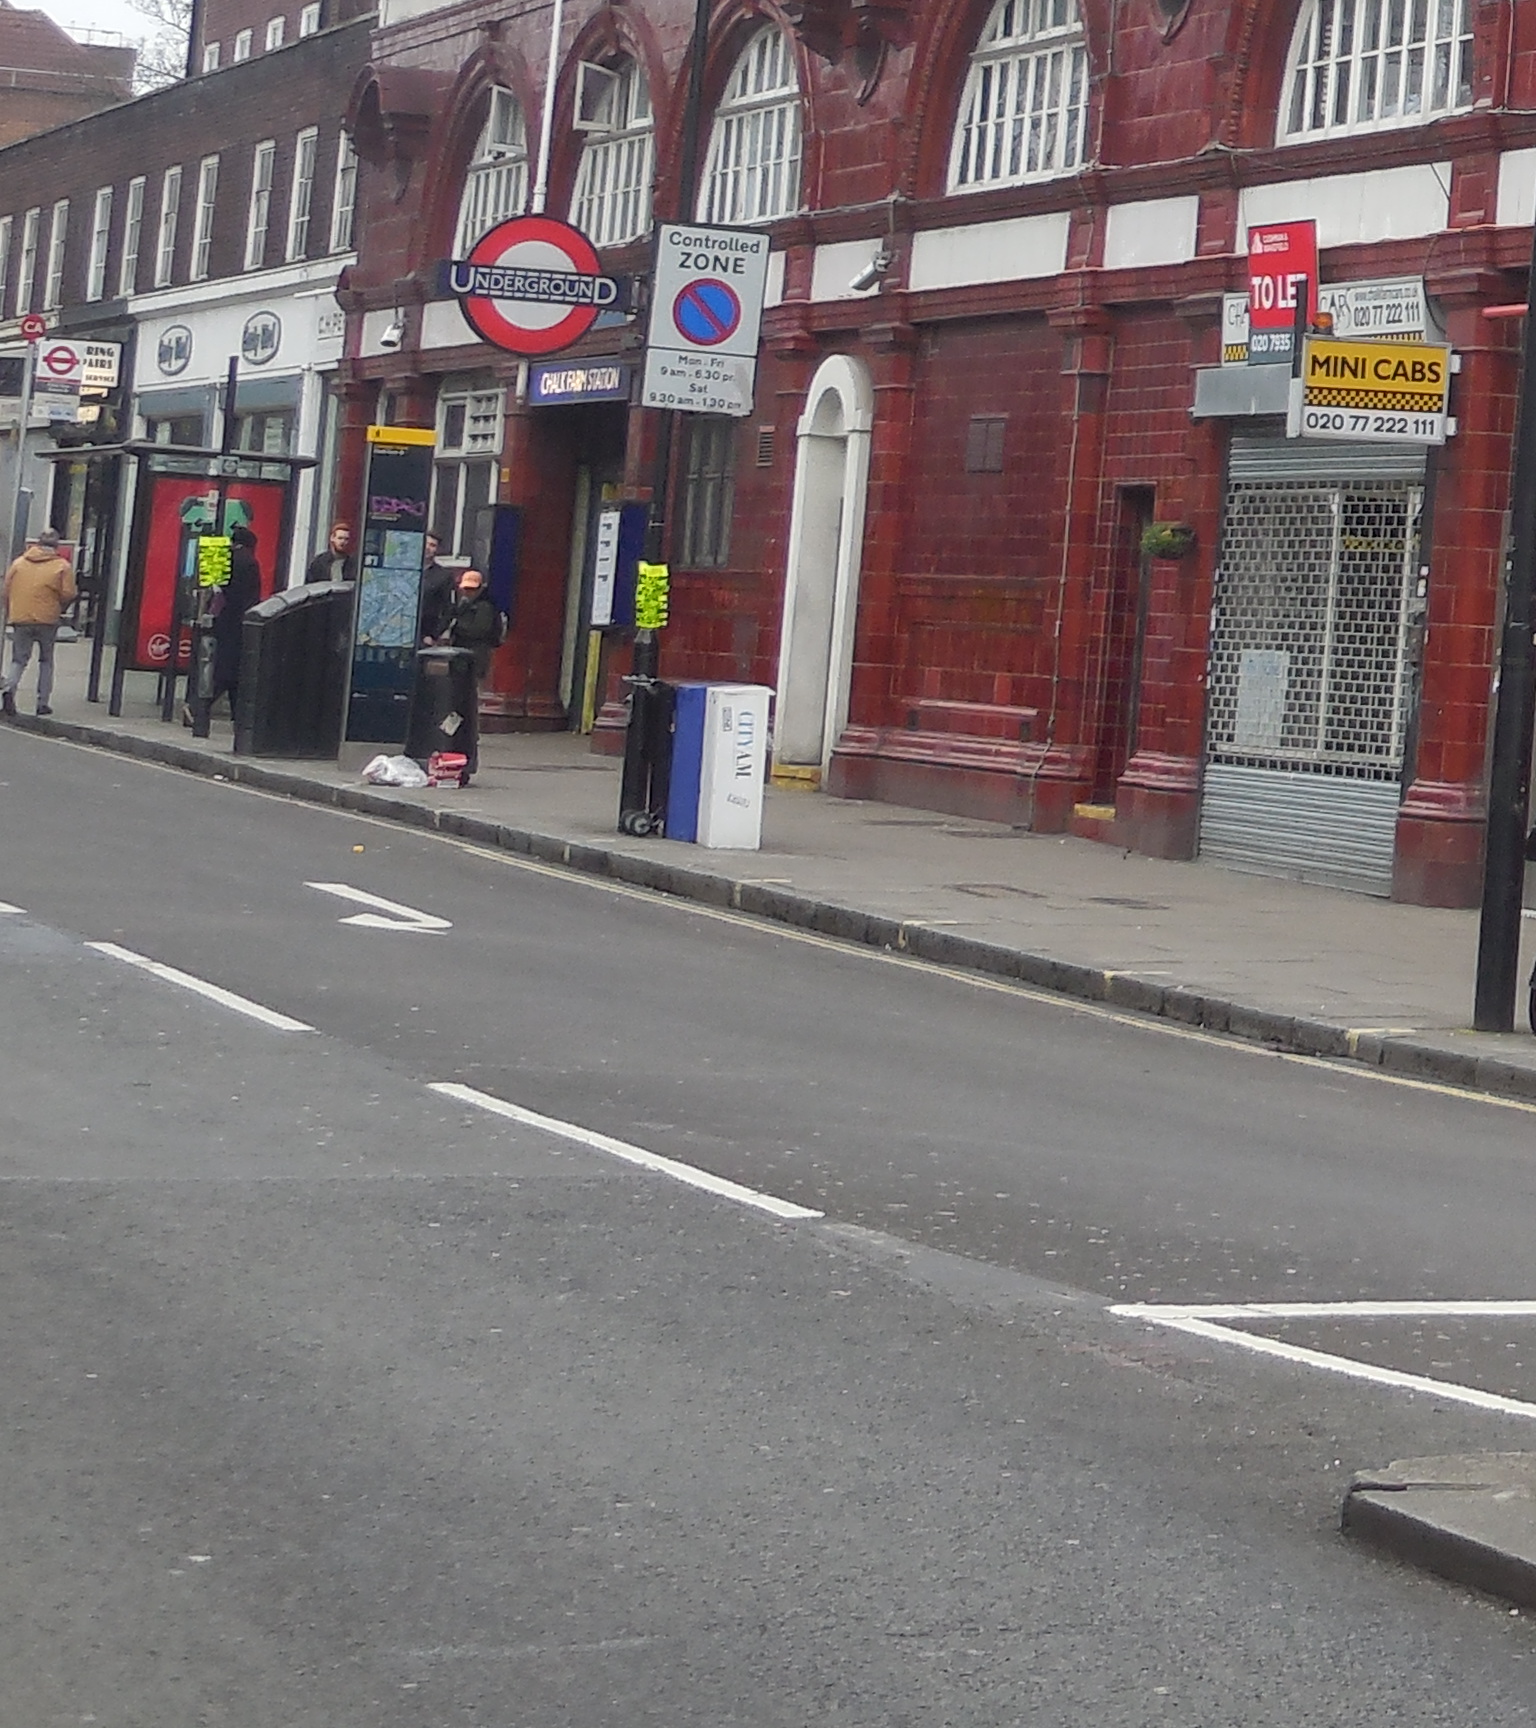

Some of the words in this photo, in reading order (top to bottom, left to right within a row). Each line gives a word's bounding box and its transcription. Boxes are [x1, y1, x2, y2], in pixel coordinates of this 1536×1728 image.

[669, 231, 761, 254] Controlled
[679, 252, 746, 274] ZONE
[450, 264, 618, 305] UNDERGROUND
[1251, 275, 1274, 309] TO
[1354, 306, 1370, 326] 020
[1372, 305, 1384, 325] 77
[1386, 303, 1403, 324] 222
[1405, 301, 1420, 322] 111
[1251, 334, 1268, 352] 020
[710, 357, 725, 368] Fri
[1310, 354, 1367, 379] MINI
[1373, 358, 1441, 383] CABS
[689, 383, 708, 394] Sat
[1306, 413, 1344, 430] 020
[1349, 415, 1370, 432] 77
[1373, 416, 1408, 433] 222
[1413, 419, 1435, 435] 111
